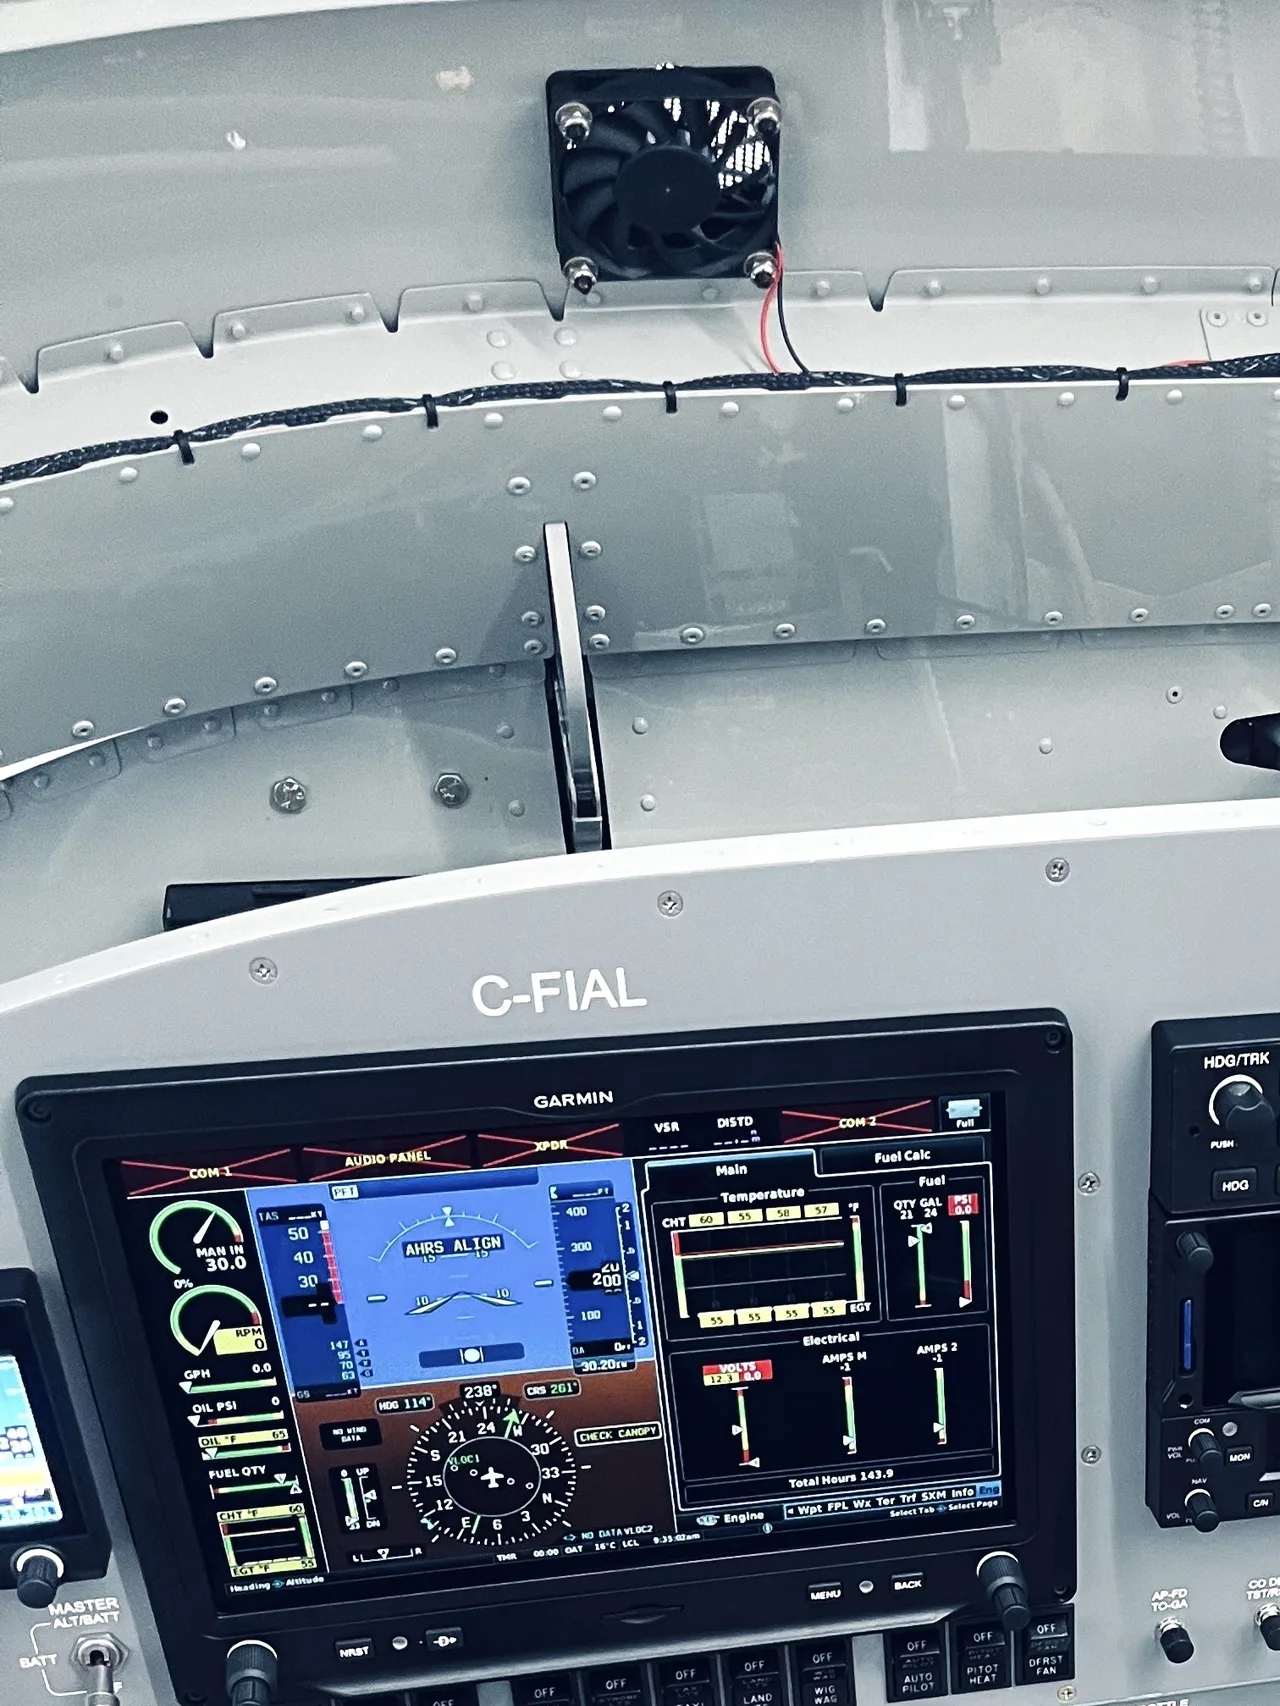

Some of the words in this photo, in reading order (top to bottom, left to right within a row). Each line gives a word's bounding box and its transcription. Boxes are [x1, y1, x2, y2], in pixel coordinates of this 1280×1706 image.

[472, 967, 647, 1017] C-FIAL
[1203, 1051, 1270, 1069] HDG/TRK
[533, 1090, 613, 1108] GARMIN
[654, 1121, 680, 1133] VSR
[717, 1115, 753, 1129] DISTD
[956, 1119, 974, 1128] Full
[344, 1153, 381, 1167] AUDIO
[383, 1150, 431, 1164] PANEL
[875, 1150, 900, 1163] Fuel
[903, 1148, 930, 1161] Calc
[716, 1163, 747, 1177] Main
[918, 1175, 946, 1188] Fuel
[1222, 1178, 1249, 1192] HDG
[720, 1186, 804, 1204] Temperature
[894, 1199, 917, 1211] QTY
[920, 1197, 942, 1209] GAL
[662, 1217, 686, 1229] CHT
[196, 1246, 224, 1257] MAN
[227, 1244, 244, 1256] IN
[405, 1240, 445, 1257] AHRS
[452, 1236, 501, 1252] ALIGN
[206, 1255, 247, 1272] 30.0
[850, 1301, 871, 1313] EGT
[802, 1331, 860, 1346] Electrical
[579, 1430, 614, 1442] CHECK
[618, 1424, 657, 1438] CANOPY
[1229, 1451, 1251, 1464] MON
[209, 1468, 238, 1479] FUEL
[241, 1465, 267, 1477] QTY
[789, 1476, 819, 1489] Total
[822, 1473, 856, 1486] Hours
[860, 1468, 894, 1482] 143.9
[798, 1502, 823, 1517] Wpt
[827, 1501, 848, 1512] FPL
[853, 1497, 871, 1510] Wx
[876, 1495, 896, 1507] Ter
[900, 1491, 918, 1504] Trf
[921, 1489, 947, 1501] SXM
[951, 1485, 974, 1498] Info
[723, 1510, 765, 1525] Engine
[894, 1578, 922, 1590] BACK
[1248, 1578, 1267, 1589] CO
[810, 1588, 841, 1600] MENU
[1153, 1587, 1188, 1603] AP-FD
[48, 1597, 119, 1616] MASTER
[1151, 1599, 1188, 1611] TO-GA
[53, 1611, 120, 1628] ALT/BATT
[1037, 1623, 1056, 1635] OFF
[973, 1631, 992, 1643] OFF
[340, 1646, 369, 1657] NRST
[907, 1640, 927, 1651] OFF
[20, 1654, 57, 1668] BATT
[813, 1652, 833, 1664] OFF
[1029, 1655, 1062, 1668] DFRST
[744, 1660, 765, 1672] OFF
[967, 1664, 998, 1676] PITOT
[1036, 1665, 1056, 1676] FAN
[676, 1669, 696, 1681] OFF
[904, 1673, 932, 1685] AUTO
[969, 1673, 998, 1684] HEAT
[606, 1678, 626, 1690] OFF
[902, 1682, 935, 1693] PILOT
[534, 1686, 555, 1699] OFF
[814, 1686, 835, 1696] WIG
[744, 1693, 772, 1705] LAND
[814, 1693, 837, 1704] WAG
